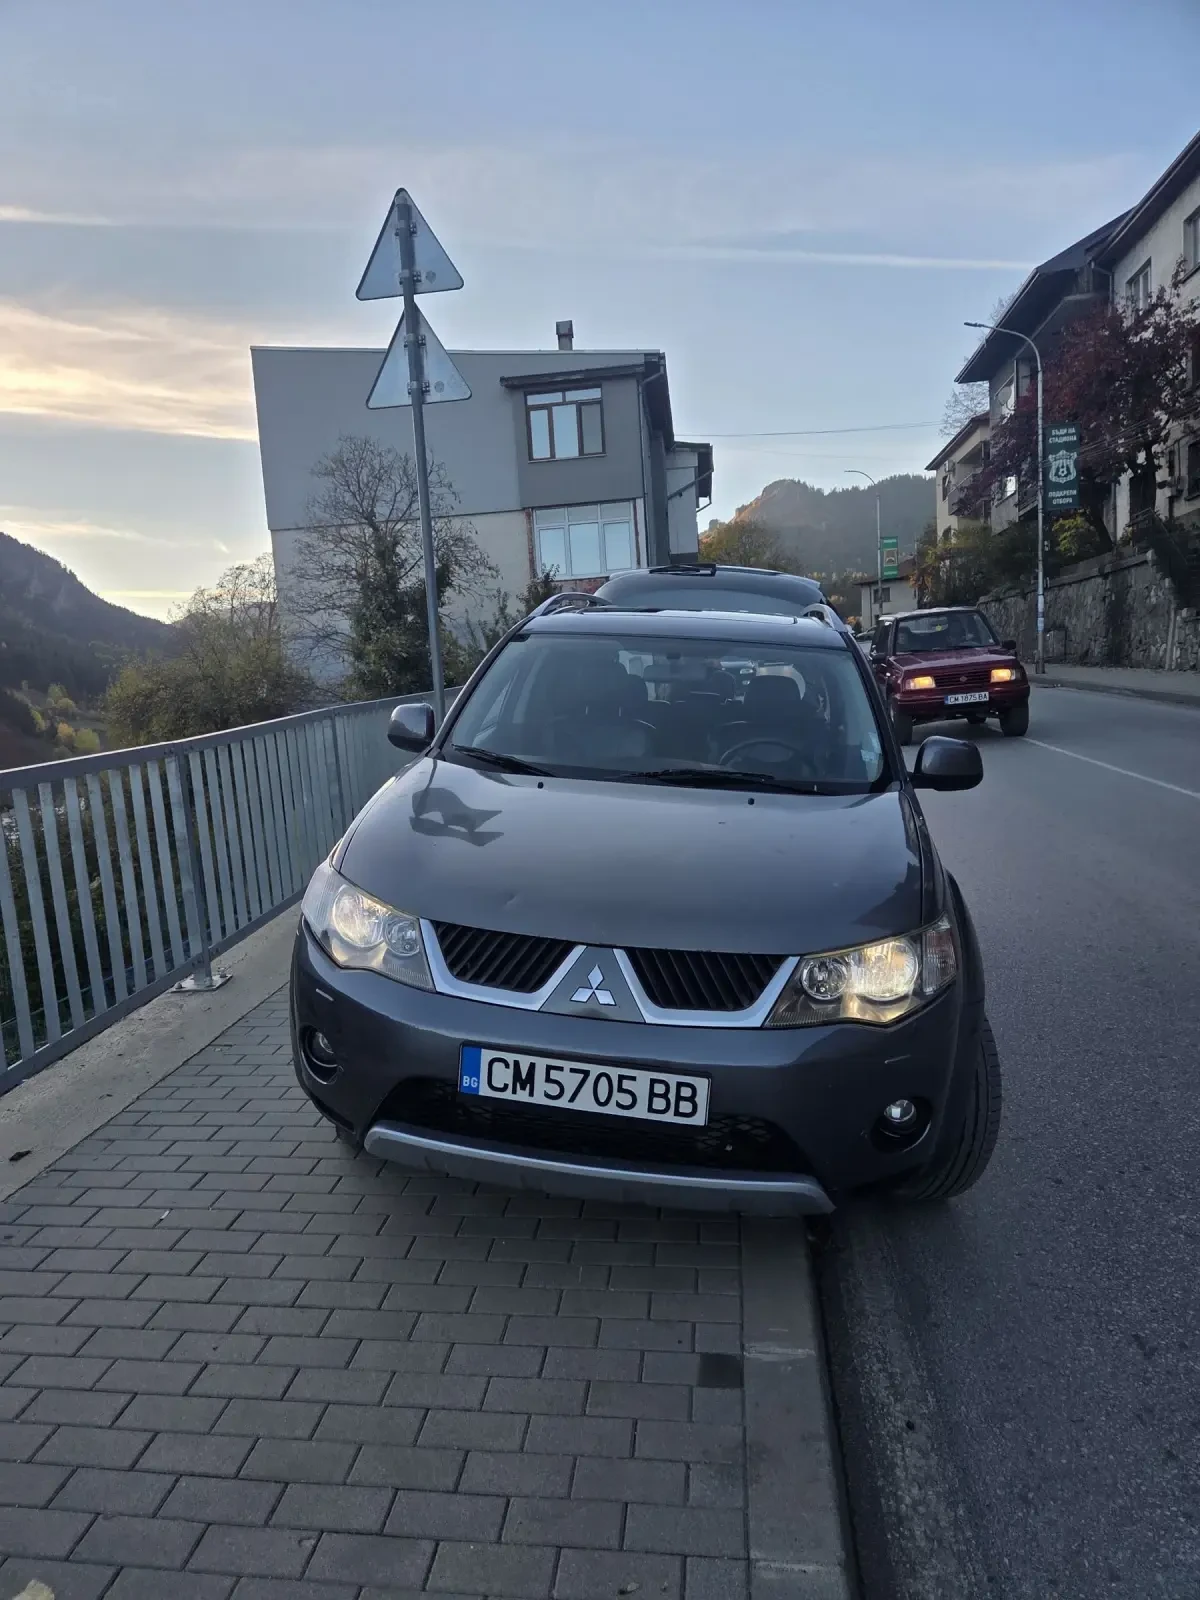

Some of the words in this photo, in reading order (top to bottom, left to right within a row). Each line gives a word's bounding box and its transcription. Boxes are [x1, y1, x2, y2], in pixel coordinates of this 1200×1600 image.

[1048, 435, 1077, 444] СТАДИОНА
[961, 694, 977, 702] 1875
[462, 1075, 478, 1088] BG
[486, 1057, 537, 1098] CM
[543, 1065, 638, 1111] 5705
[646, 1077, 698, 1119] BB
